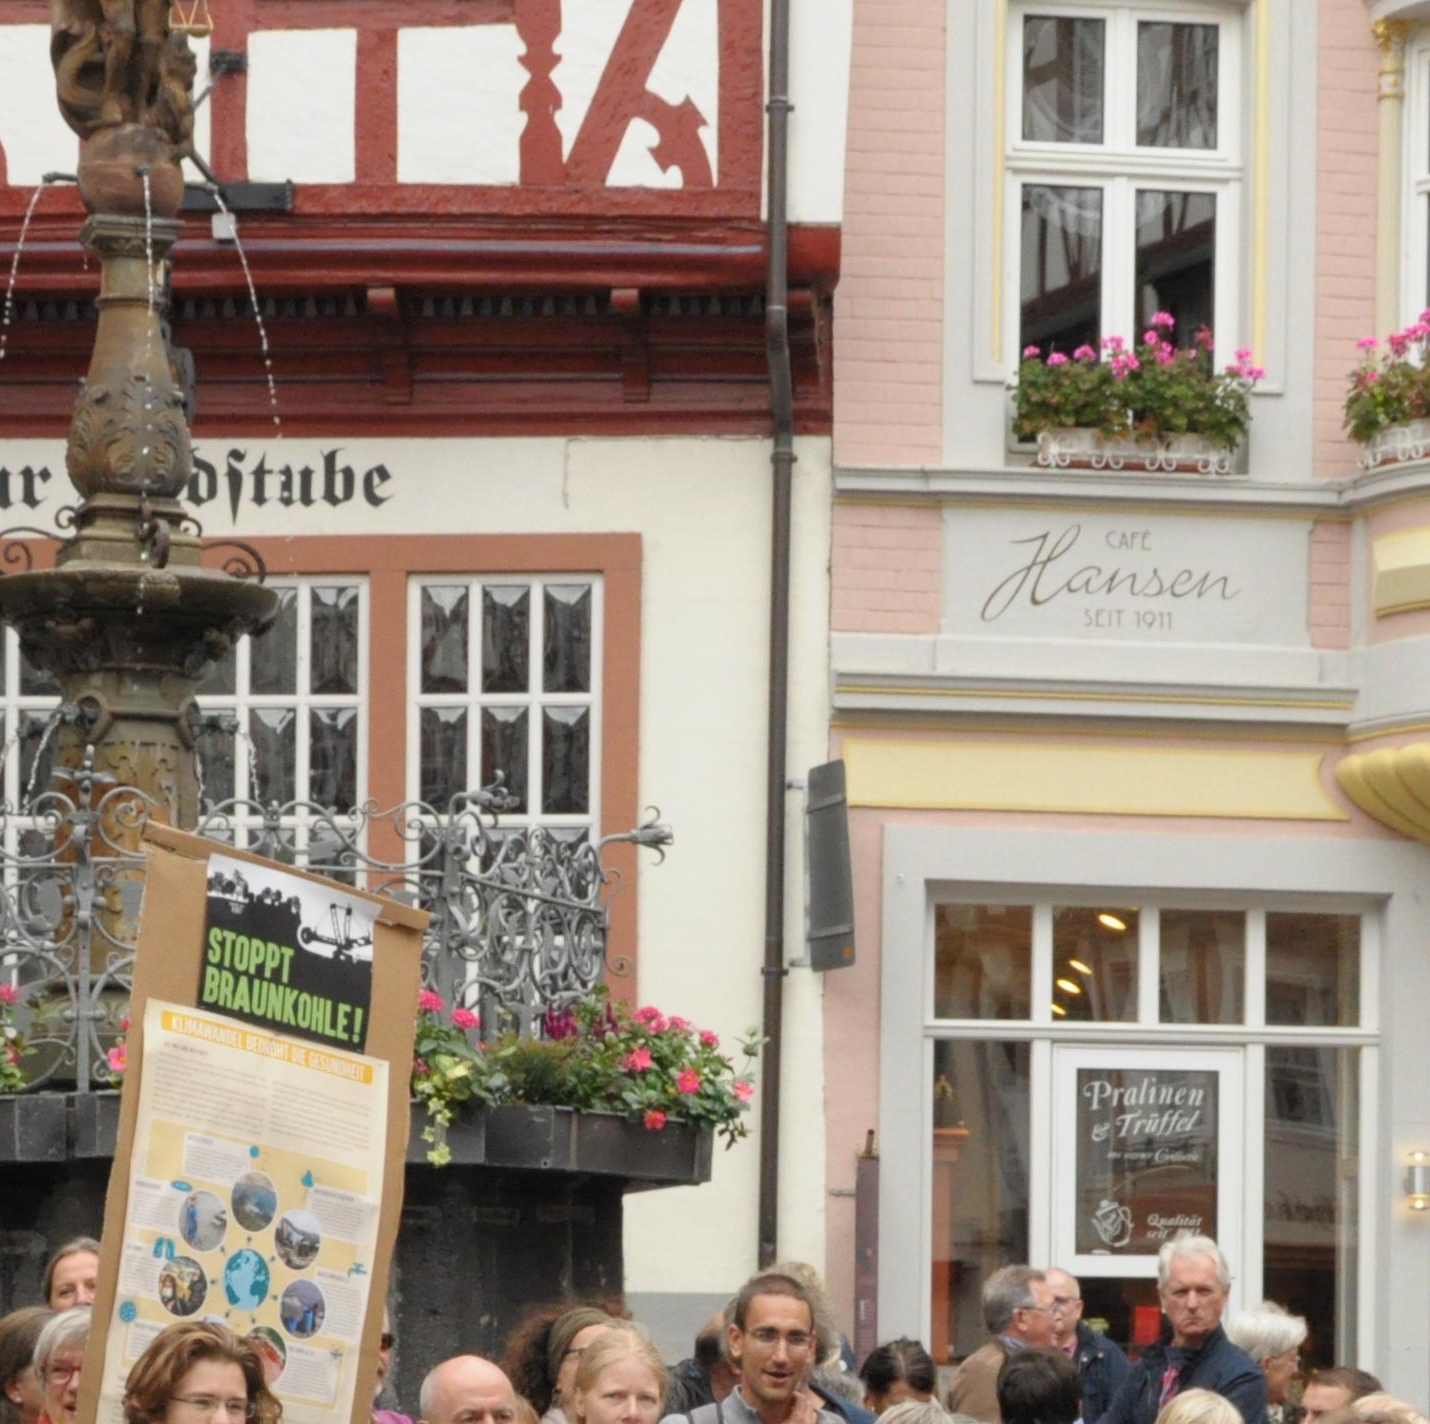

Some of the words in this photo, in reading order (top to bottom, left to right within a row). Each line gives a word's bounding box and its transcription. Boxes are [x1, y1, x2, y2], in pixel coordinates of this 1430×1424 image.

[1105, 528, 1153, 551] CAFÉ
[980, 523, 1241, 623] Hansen
[1083, 608, 1124, 628] SEIT
[1135, 610, 1173, 631] 1911
[207, 926, 295, 984] STOPPT
[171, 1014, 244, 1050] KLIMAWANDEL
[245, 1033, 290, 1061] BEDROHT
[291, 1045, 308, 1065] DIE
[307, 1048, 366, 1082] GESUNDHEIT
[1082, 1077, 1204, 1111] Pralinen
[1091, 1122, 1111, 1142] &
[1115, 1108, 1200, 1137] Trüffel
[1147, 1213, 1204, 1227] Qualität
